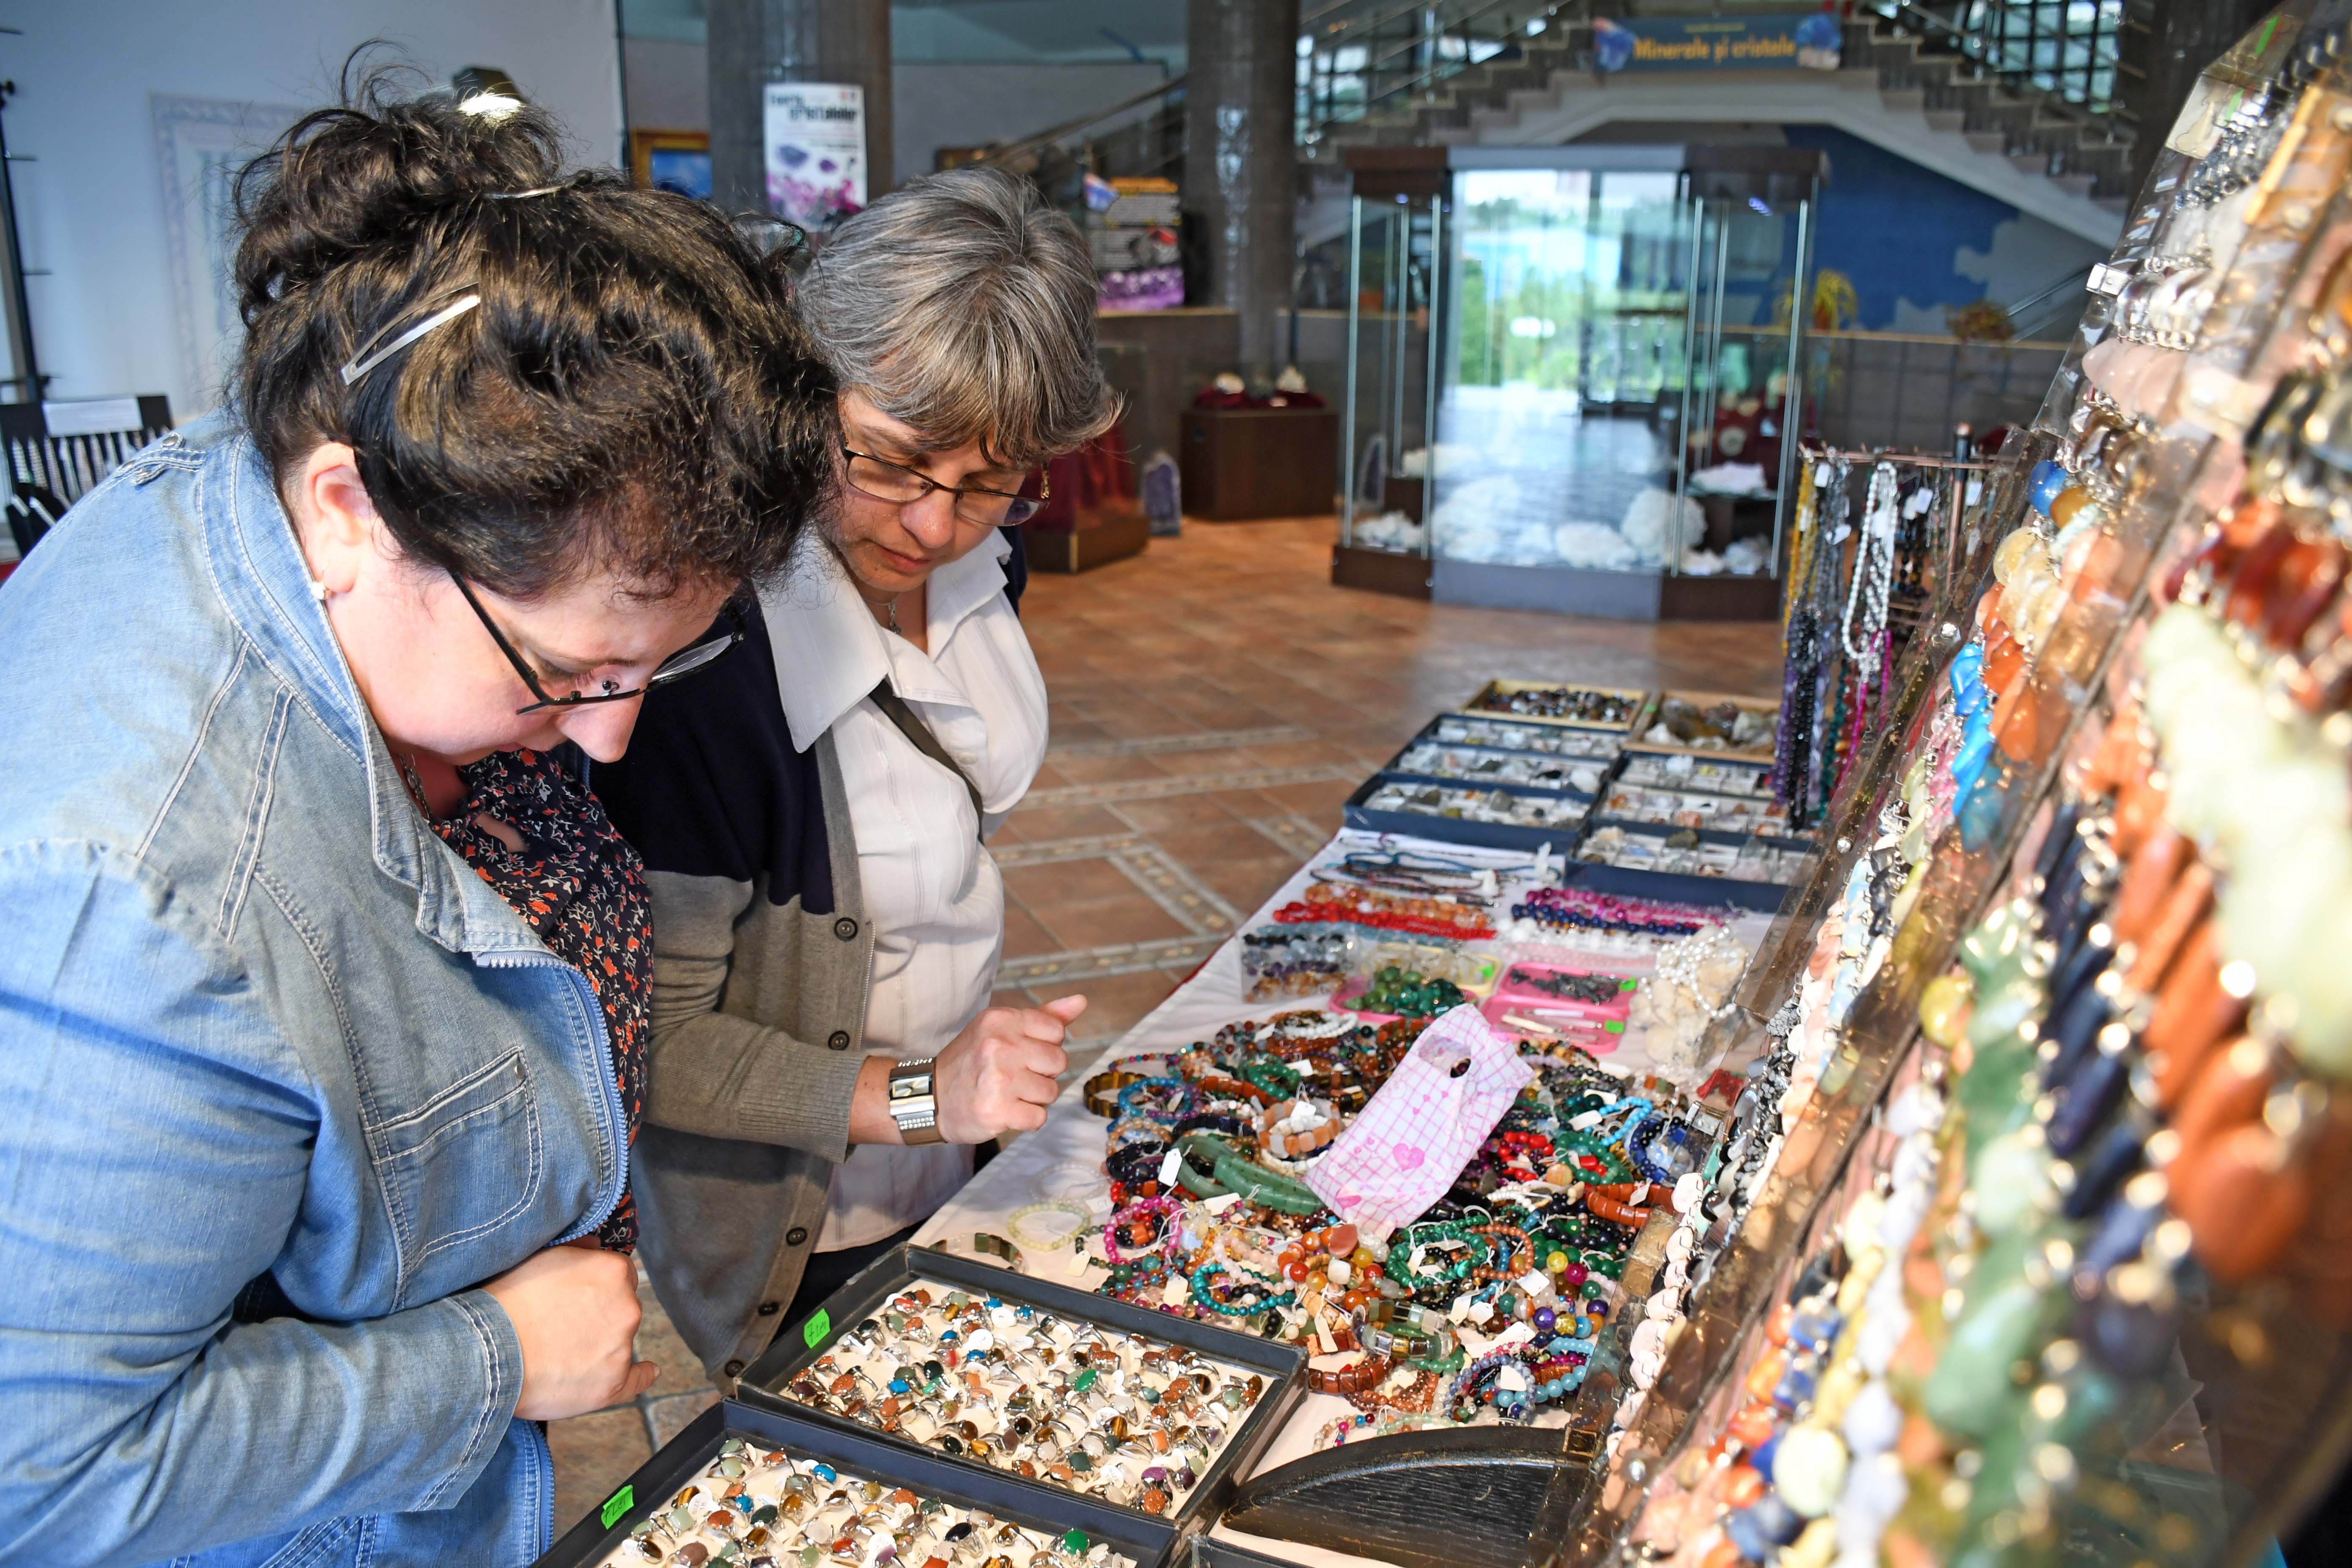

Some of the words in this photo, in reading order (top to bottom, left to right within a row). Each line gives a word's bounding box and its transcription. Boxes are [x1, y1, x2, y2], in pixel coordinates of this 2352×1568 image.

[1633, 35, 1710, 60] Minerale
[1731, 33, 1796, 58] cristale
[807, 1323, 815, 1343] 7
[604, 1509, 610, 1523] 7
